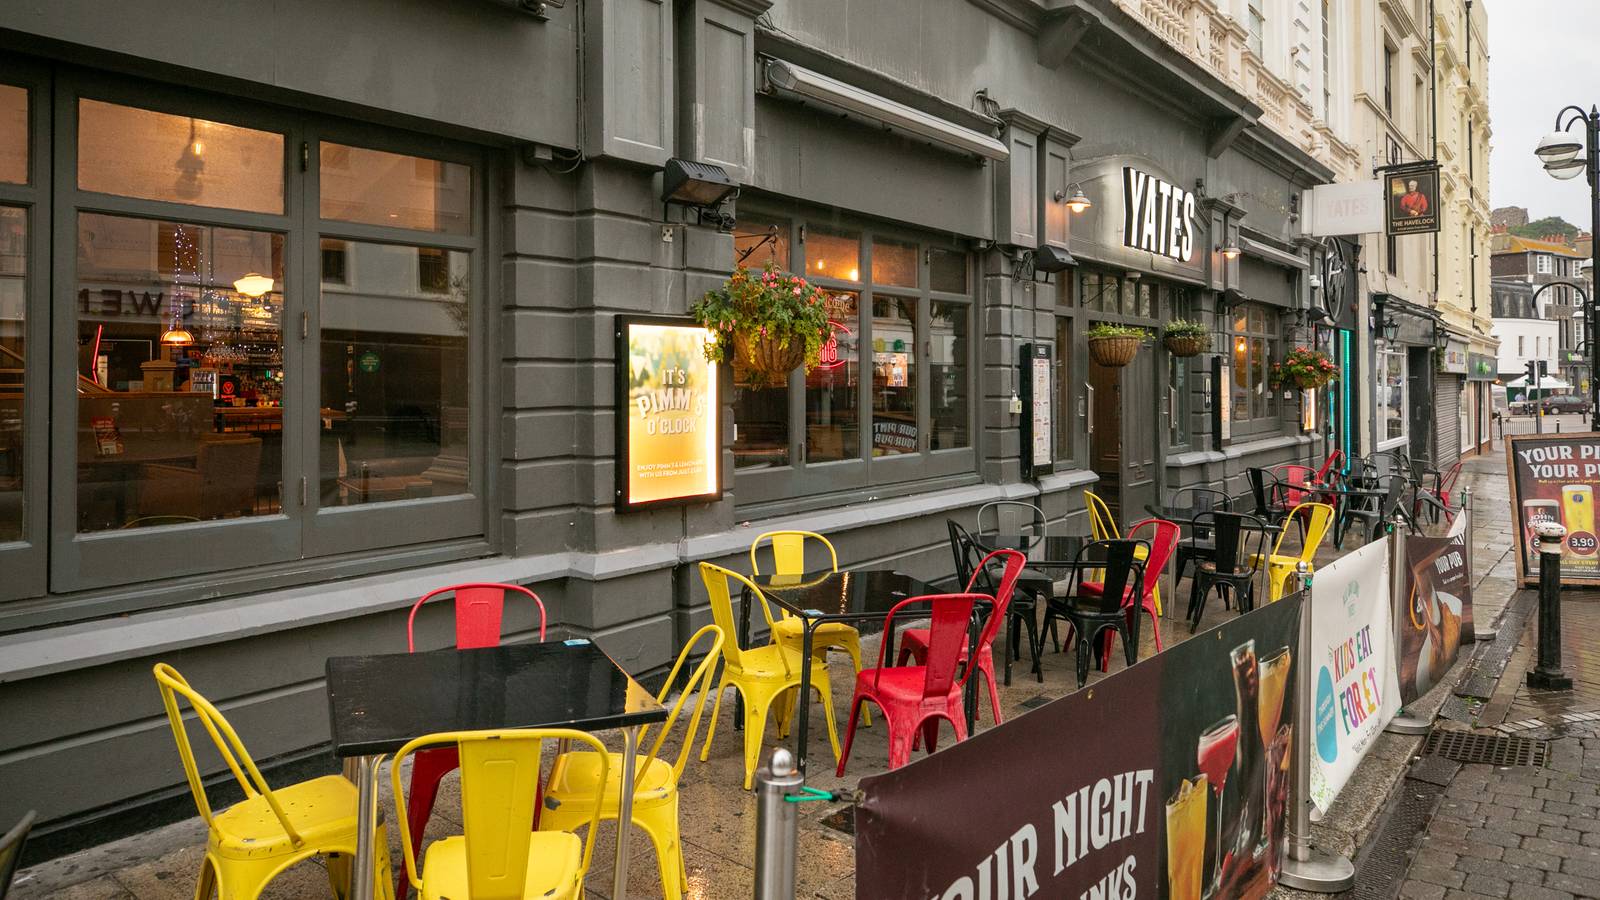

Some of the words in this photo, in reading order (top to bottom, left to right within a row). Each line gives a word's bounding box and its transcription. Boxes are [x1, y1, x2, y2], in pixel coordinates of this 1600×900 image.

[1122, 166, 1195, 262] YATES
[1404, 217, 1435, 226] HAVELOCK
[662, 367, 686, 385] IT'S
[636, 387, 705, 420] PIMM'S
[647, 416, 697, 435] O'CLOCK
[1518, 445, 1573, 464] YOUR
[1529, 464, 1579, 478] YOUR
[1571, 537, 1595, 547] 3.90
[1334, 637, 1356, 684] KIDS
[1356, 624, 1374, 663] EAT
[1339, 681, 1367, 736] FOR
[1052, 769, 1154, 877] NIGHT
